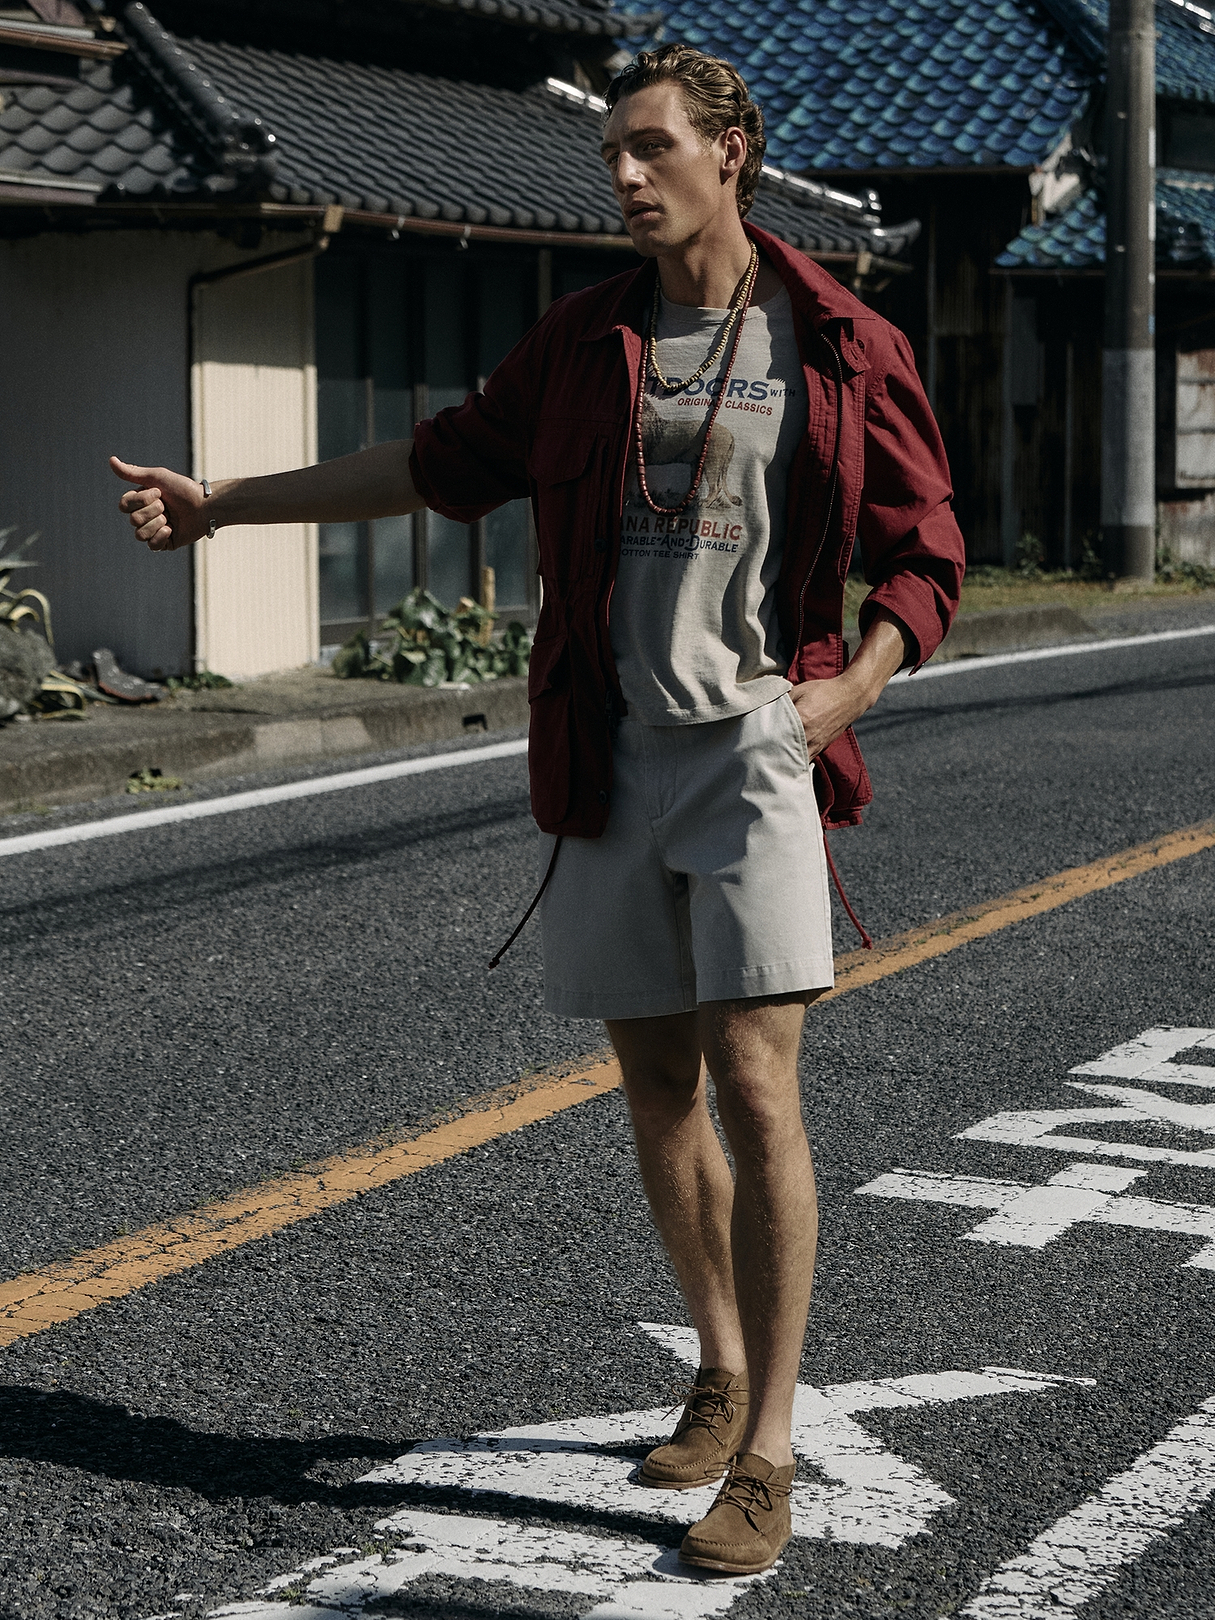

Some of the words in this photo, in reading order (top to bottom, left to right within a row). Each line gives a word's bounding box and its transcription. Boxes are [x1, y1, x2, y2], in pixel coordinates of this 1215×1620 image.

[770, 388, 795, 397] WITH
[677, 397, 719, 408] ORIGINA
[725, 400, 773, 416] CLASSICS
[620, 516, 649, 533] NA
[653, 516, 743, 541] REPUBLIC
[620, 548, 650, 557] OTTON
[653, 550, 671, 558] TEE
[673, 551, 699, 560] SHIRT
